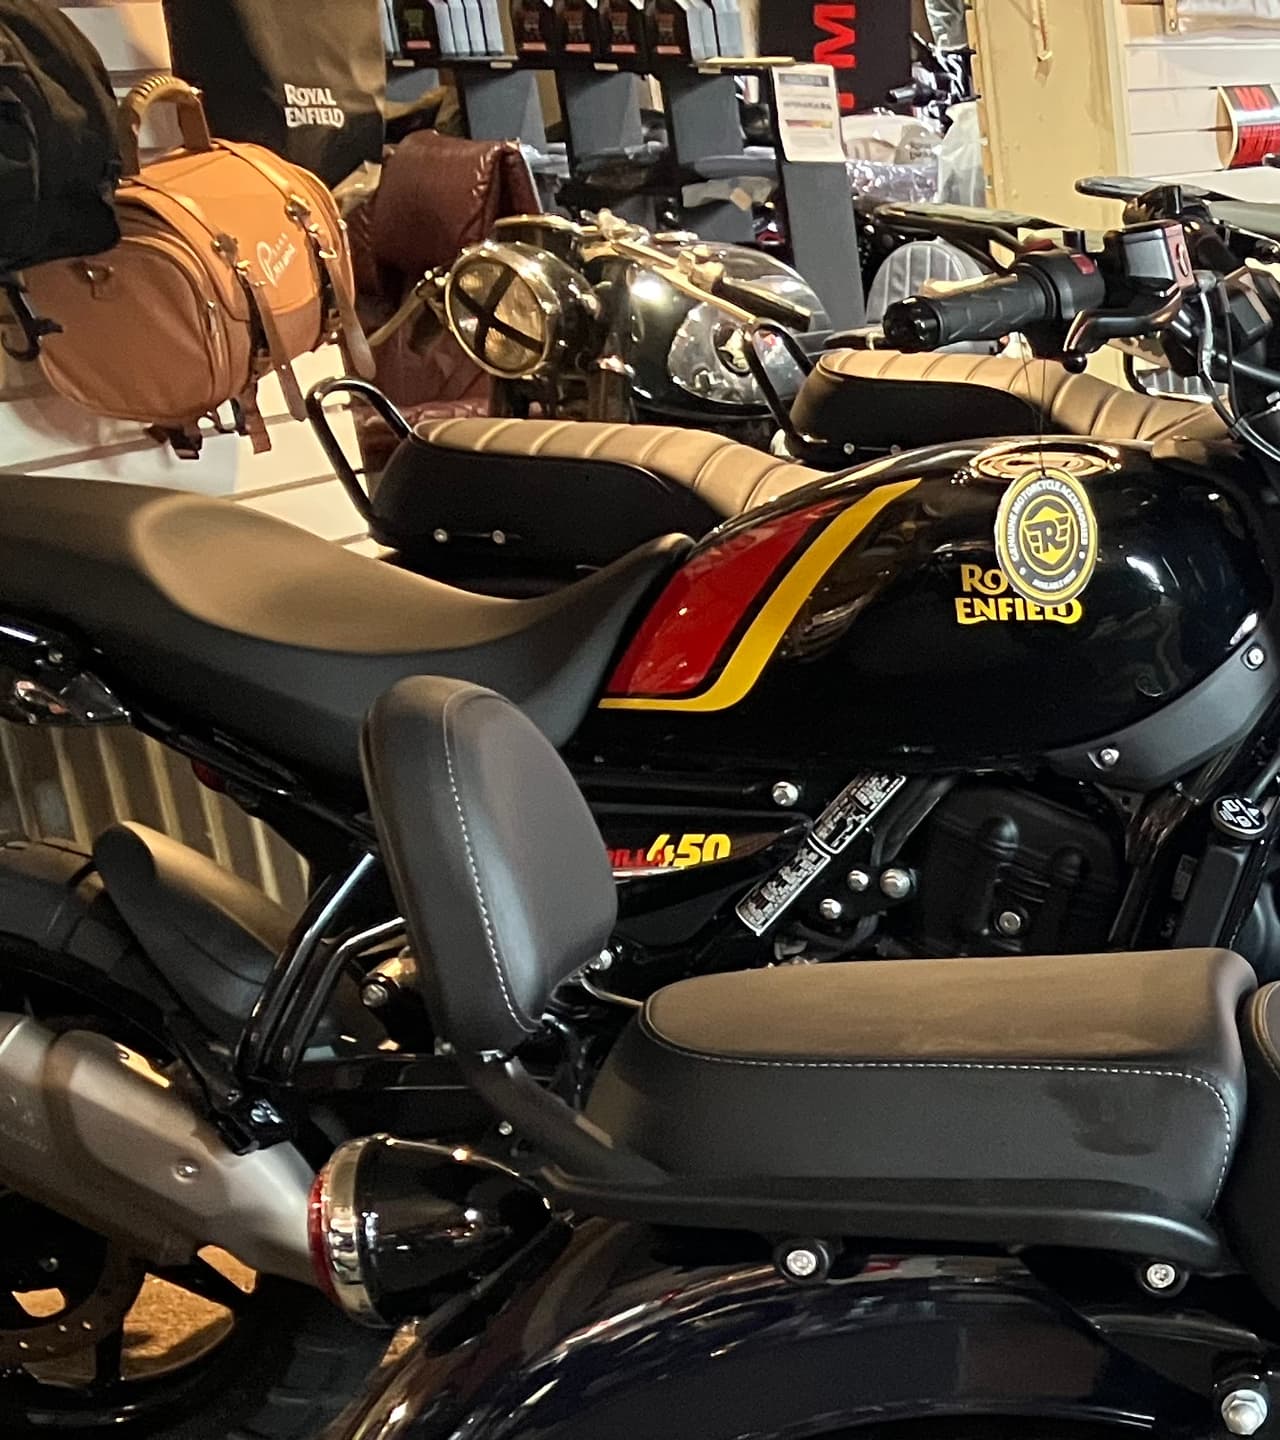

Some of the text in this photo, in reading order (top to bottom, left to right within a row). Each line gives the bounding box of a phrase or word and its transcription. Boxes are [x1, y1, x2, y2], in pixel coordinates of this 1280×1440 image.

[284, 83, 337, 107] ROYAL
[285, 106, 344, 128] ENFIELD
[646, 833, 732, 869] 450
